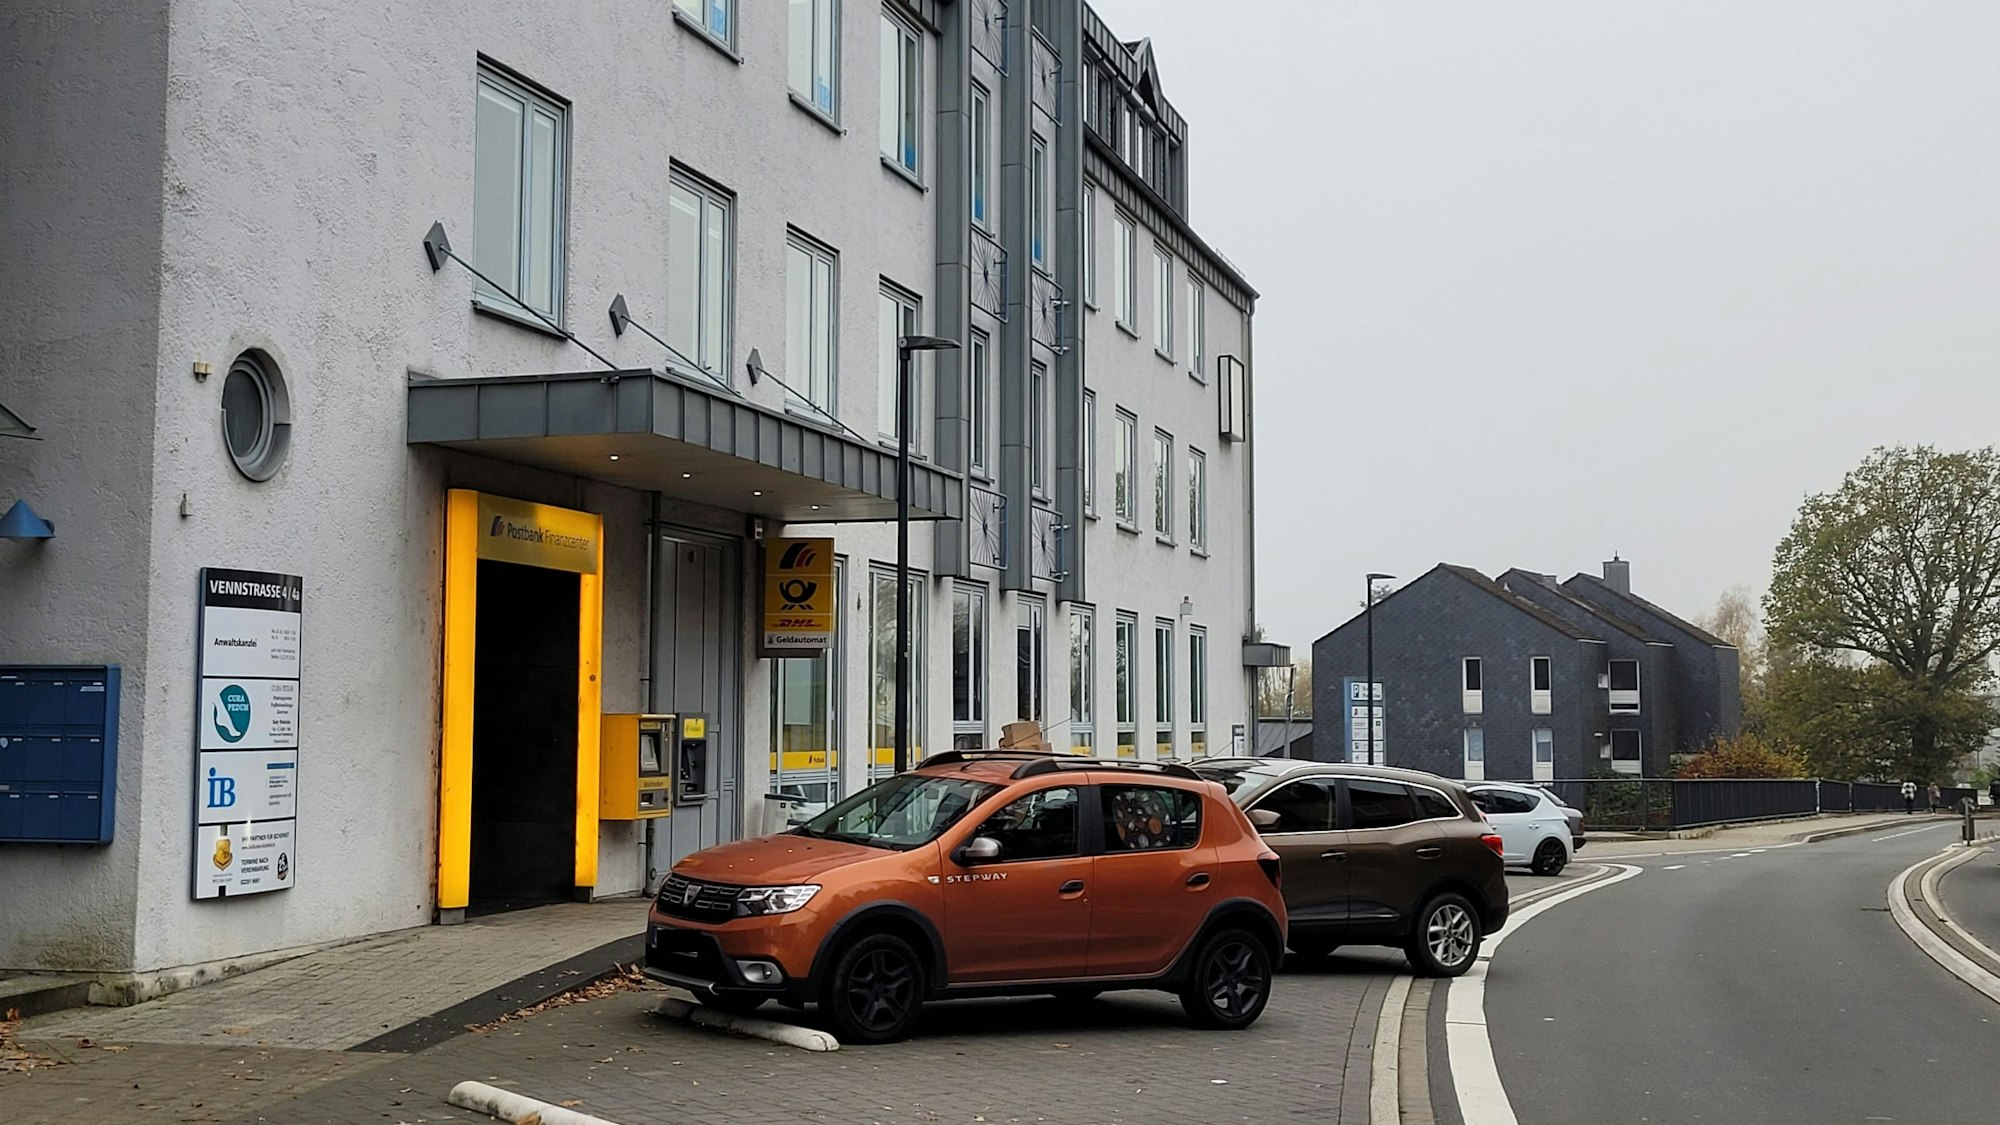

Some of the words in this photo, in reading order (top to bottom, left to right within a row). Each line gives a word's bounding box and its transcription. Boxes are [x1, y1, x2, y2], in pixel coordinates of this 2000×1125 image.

[507, 522, 544, 544] Postbank
[544, 529, 590, 550] Finanzcenter
[209, 580, 281, 598] VENNSTRASSE
[281, 587, 287, 599] 4
[291, 588, 300, 600] 4a
[214, 638, 257, 648] Anwaltskanzlei
[776, 635, 827, 644] Geldautomat
[227, 704, 249, 712] PEDUM
[207, 767, 236, 808] iB
[946, 872, 1008, 884] STEPWAY
